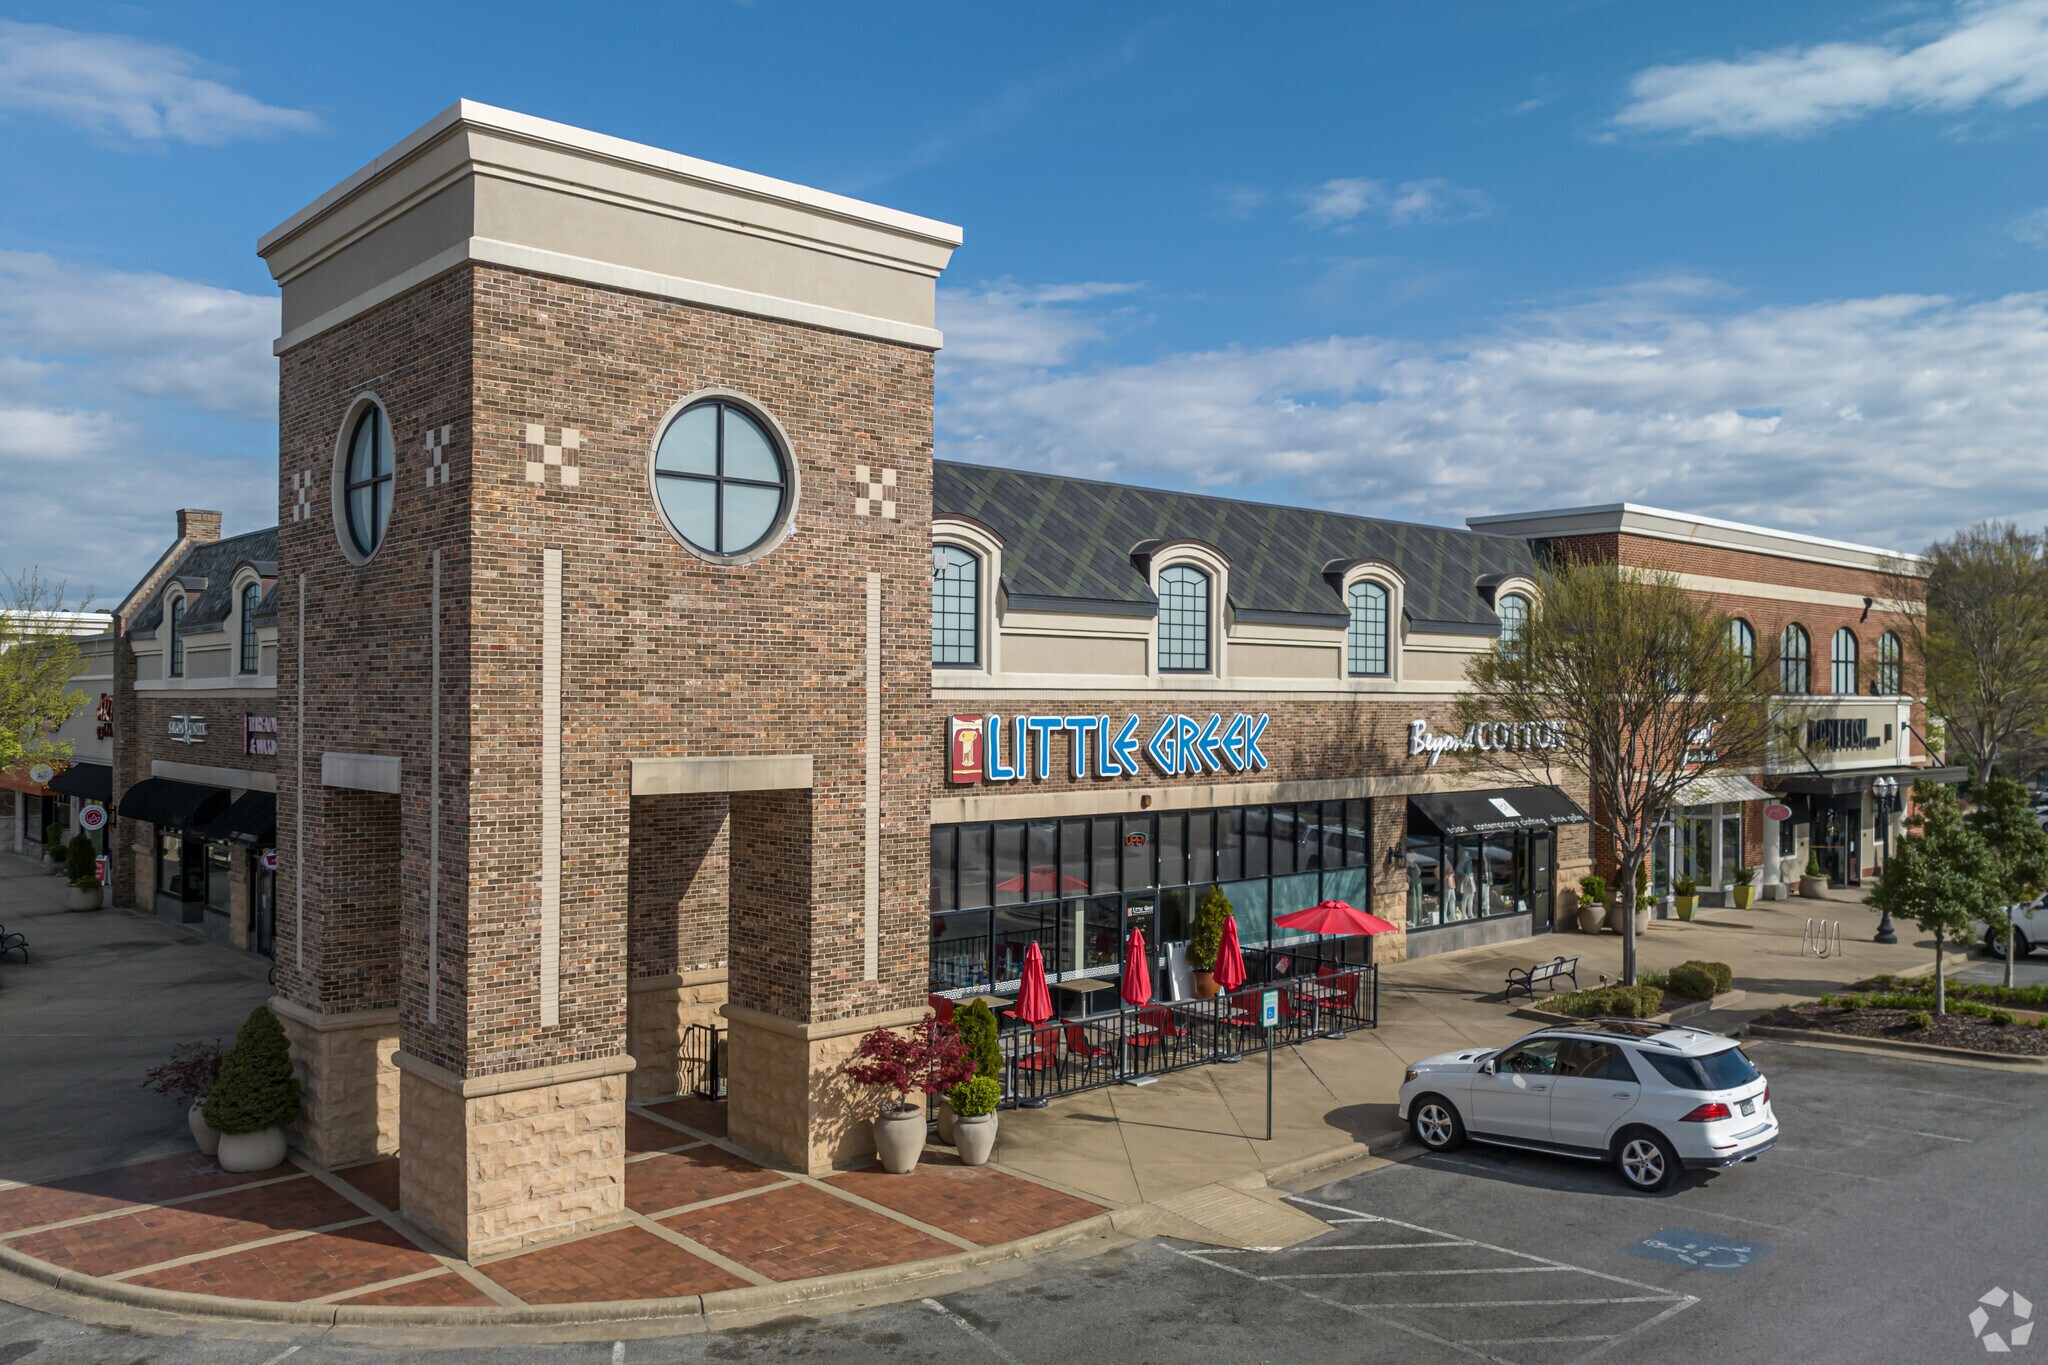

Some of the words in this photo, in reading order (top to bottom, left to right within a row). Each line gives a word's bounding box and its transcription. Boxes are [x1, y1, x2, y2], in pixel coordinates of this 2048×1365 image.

[986, 712, 1140, 781] LITTLE
[1148, 712, 1269, 776] GREEK
[1409, 719, 1475, 766] Beyond
[1475, 720, 1566, 750] COTTON
[1473, 819, 1521, 831] contemporary
[1125, 834, 1147, 846] OPEN
